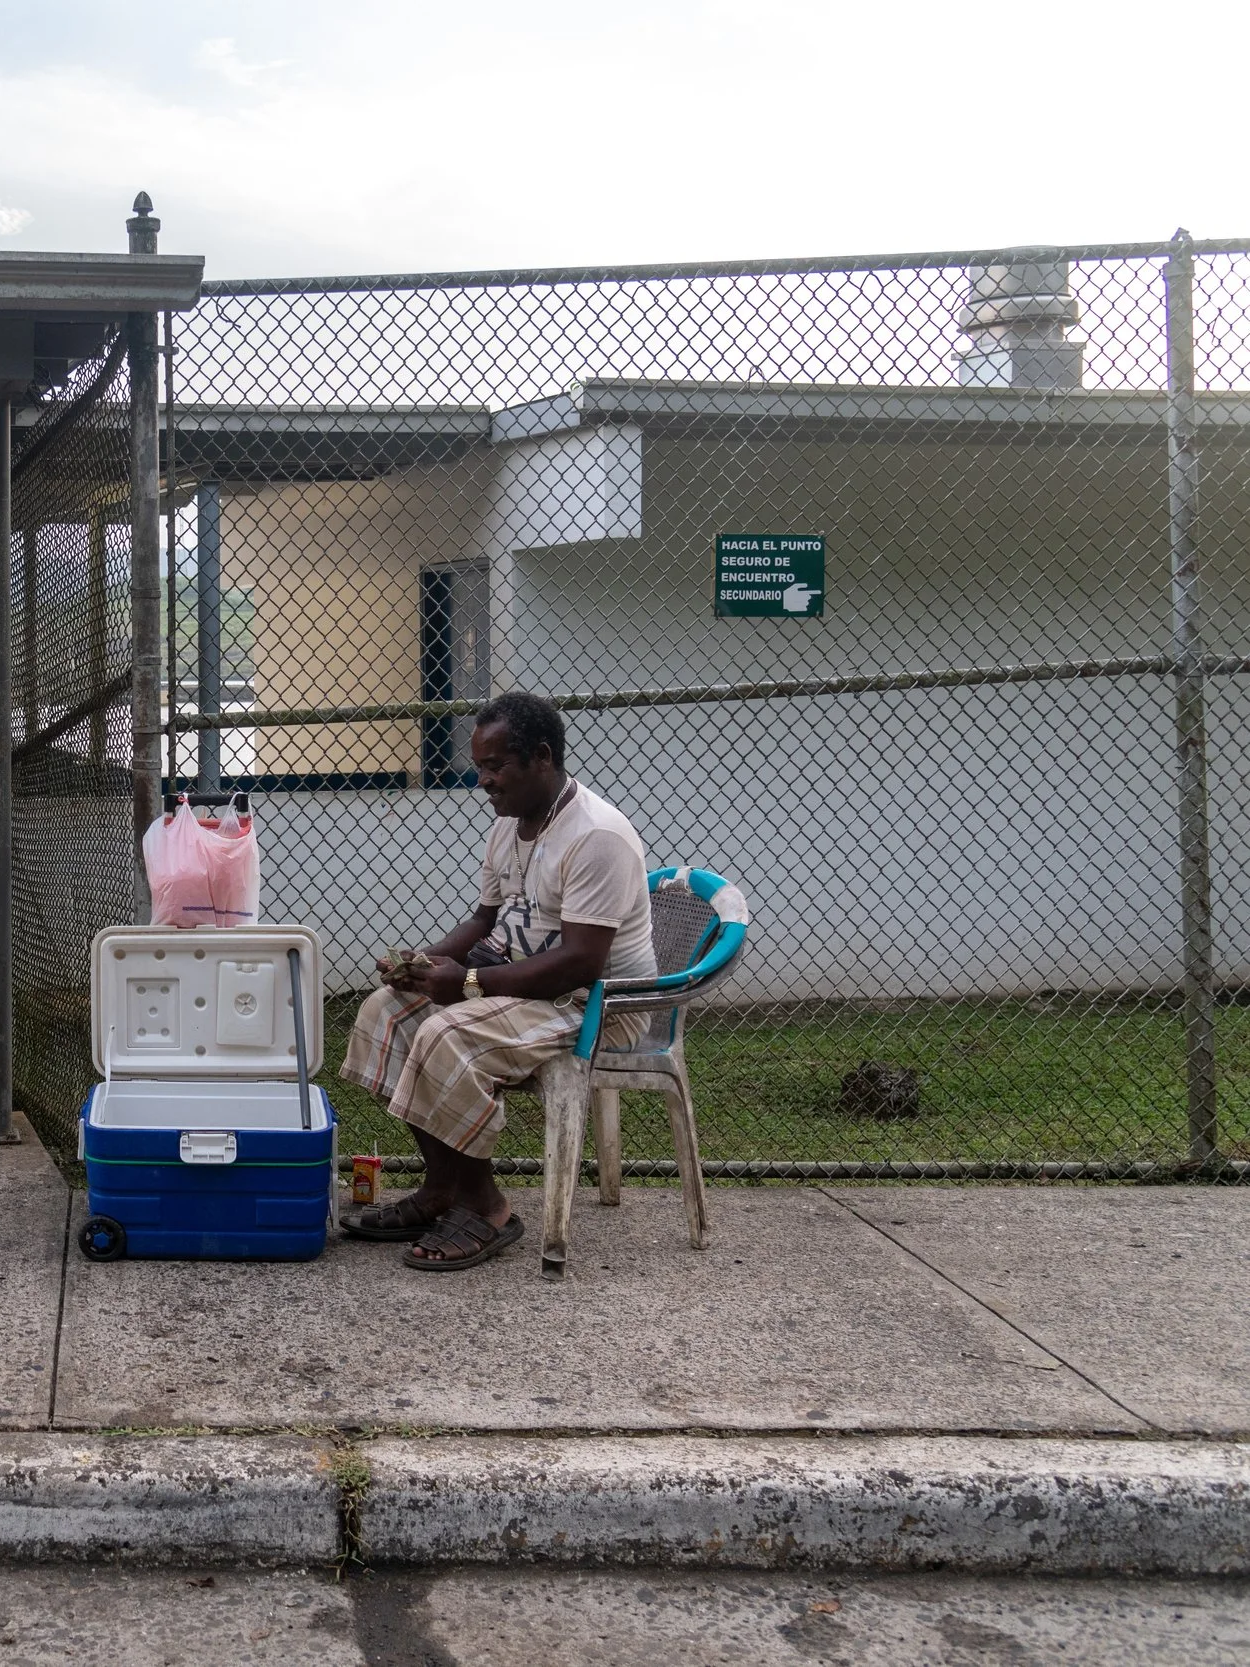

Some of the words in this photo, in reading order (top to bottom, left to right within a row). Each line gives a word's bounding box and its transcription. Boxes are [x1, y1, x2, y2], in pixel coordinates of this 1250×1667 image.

[721, 540, 759, 551] HACIA
[762, 540, 778, 551] EL
[780, 540, 822, 551] PUNTO
[721, 556, 771, 567] SEGURO
[774, 557, 791, 567] DE
[721, 572, 796, 583] ENCUENTRO
[720, 589, 782, 601] SECUNDARIO
